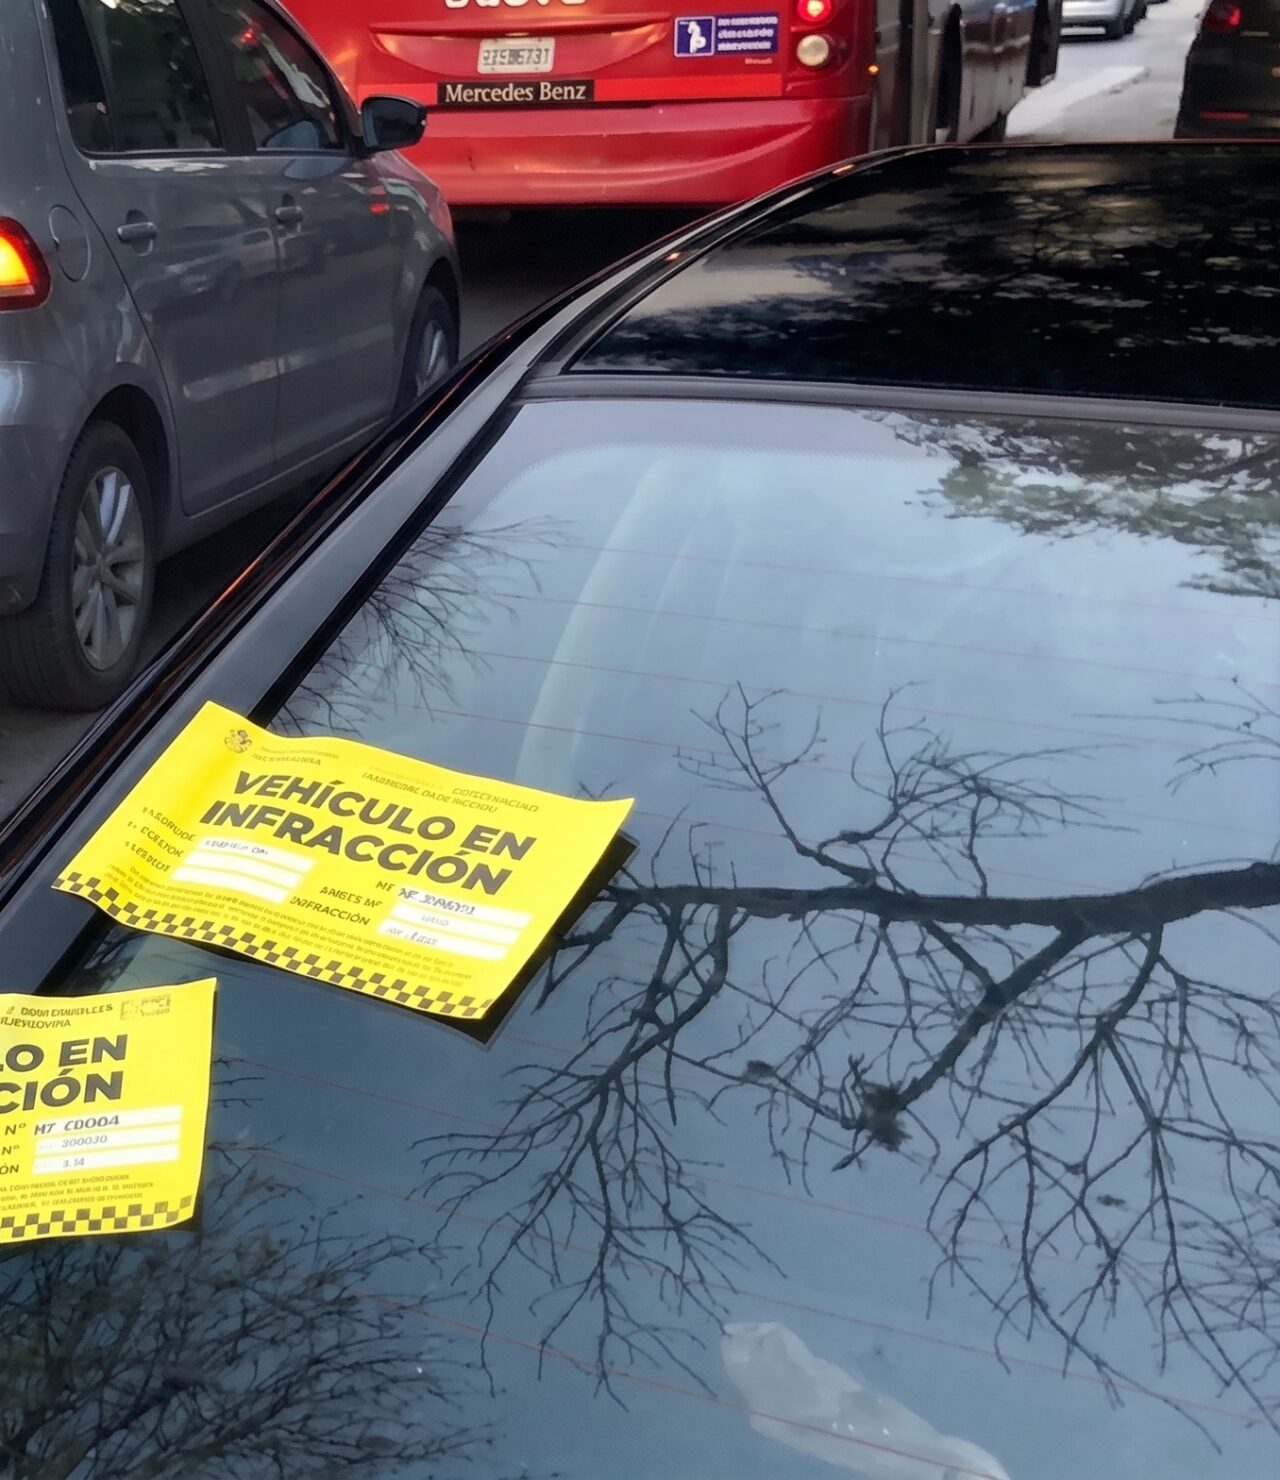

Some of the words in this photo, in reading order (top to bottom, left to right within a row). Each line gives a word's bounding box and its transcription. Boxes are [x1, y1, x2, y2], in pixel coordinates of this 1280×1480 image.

[445, 83, 534, 103] Mercedes
[539, 82, 587, 101] Benz
[223, 770, 456, 841] VEHÍCULO
[459, 824, 537, 861] EN
[199, 800, 513, 896] INFRACCIÓN
[58, 1034, 128, 1068] EN
